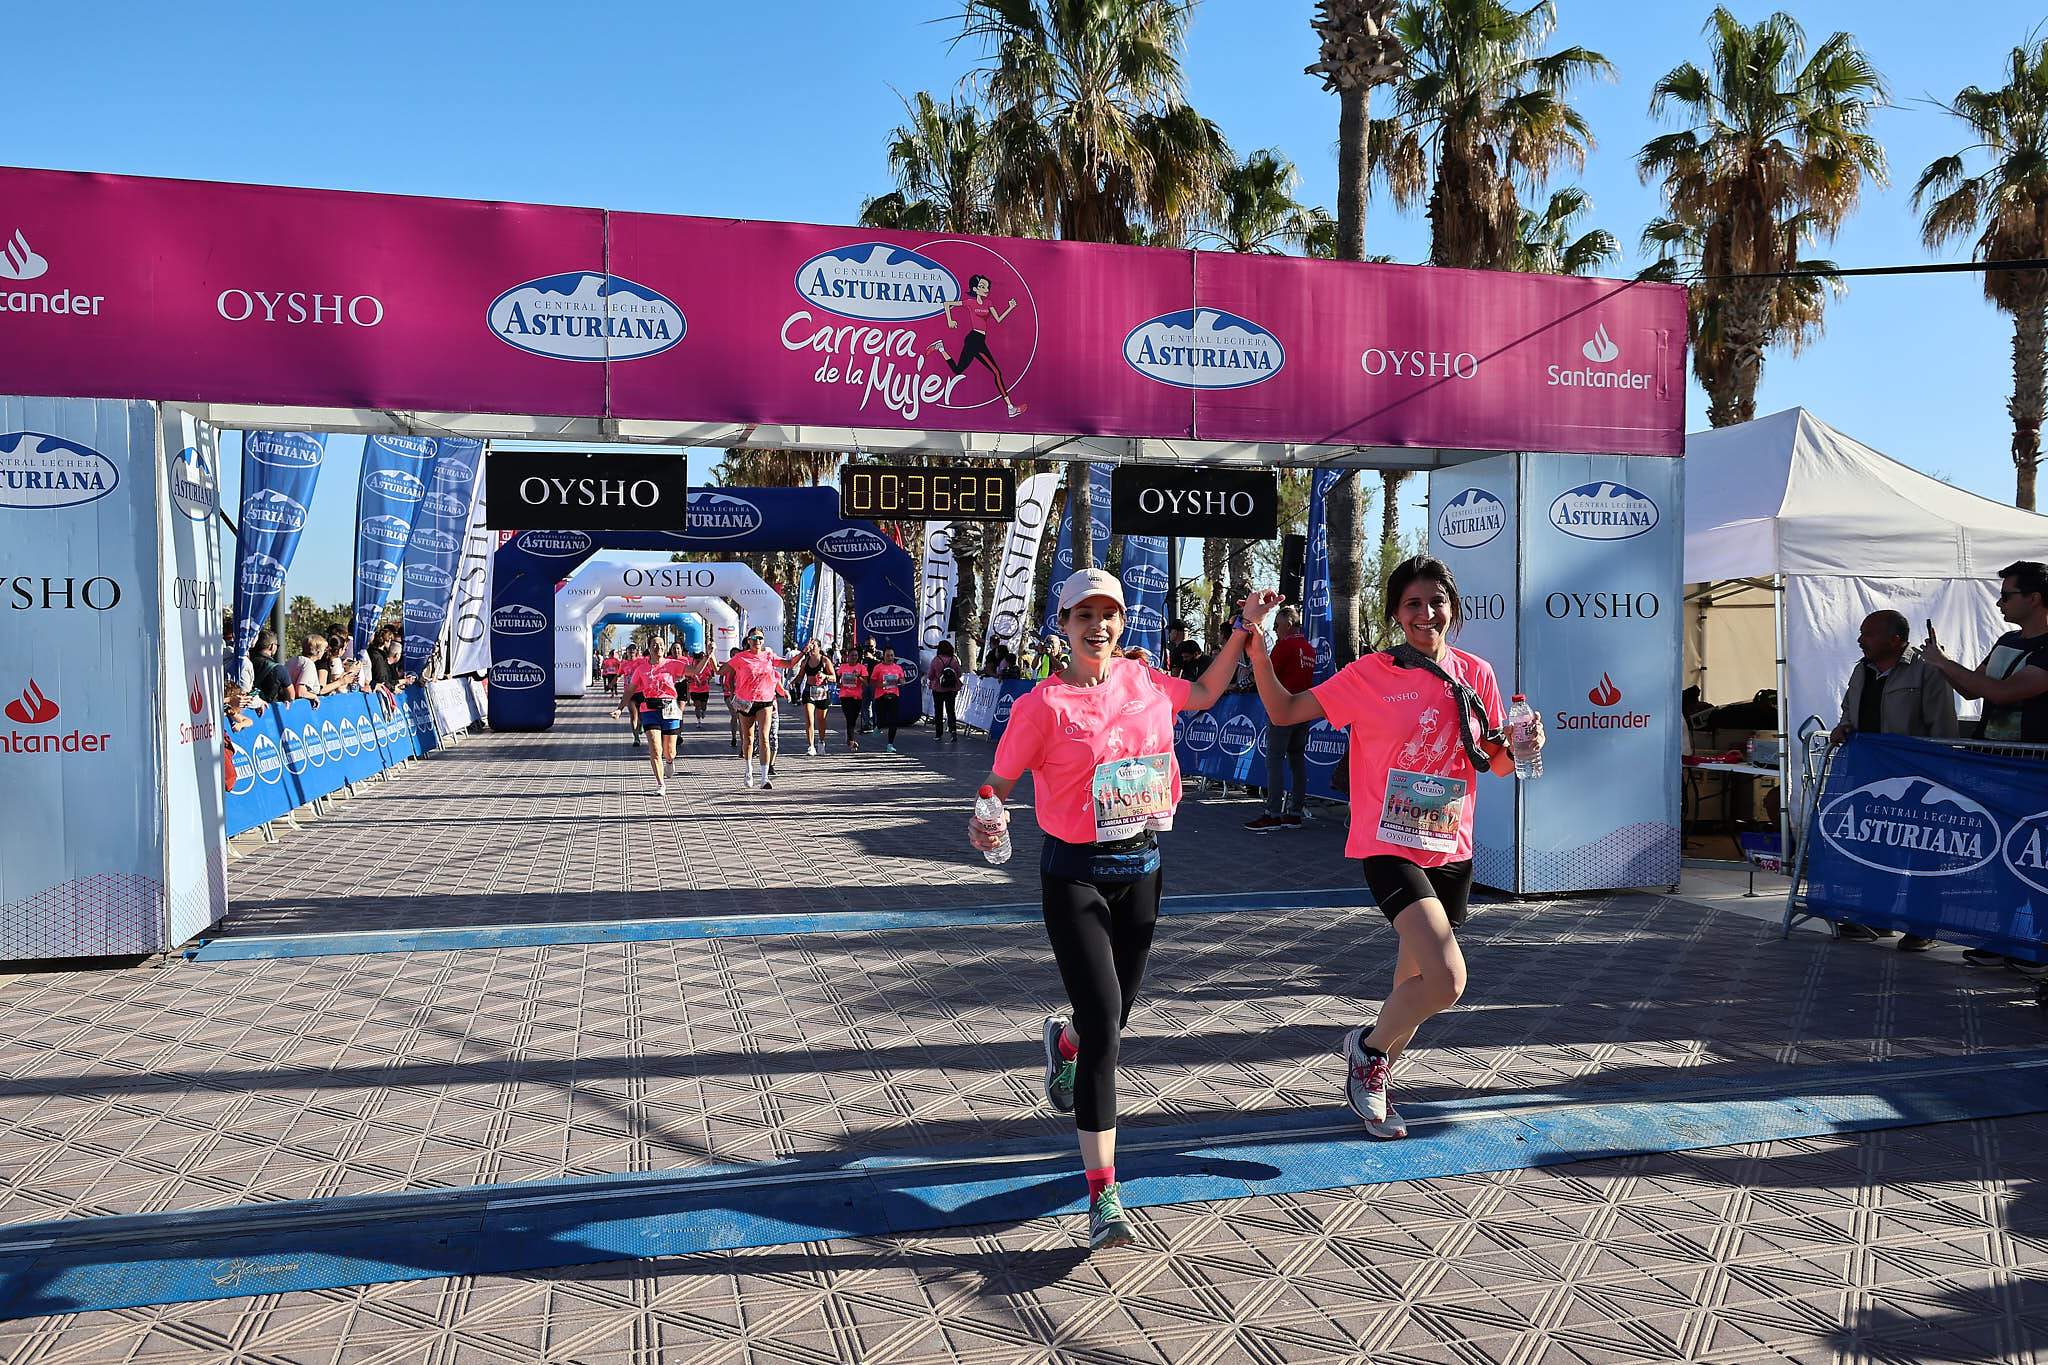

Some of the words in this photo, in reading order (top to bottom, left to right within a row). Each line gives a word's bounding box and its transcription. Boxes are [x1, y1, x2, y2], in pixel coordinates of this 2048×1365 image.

[834, 267, 887, 278] CENTRAL
[890, 270, 943, 282] LECHERA
[216, 288, 385, 328] OYSHO
[534, 300, 597, 312] CENTRAL
[780, 311, 917, 357] Carrera
[1161, 334, 1212, 345] CENTRAL
[1216, 336, 1268, 347] LECHERA
[1360, 348, 1479, 380] OYSHO
[814, 355, 840, 385] de
[845, 355, 864, 385] la
[860, 354, 967, 421] Mujer
[1547, 364, 1652, 390] Santander
[41, 459, 100, 468] LECHERA
[519, 476, 660, 508] OYSHO
[853, 474, 1003, 512] 00:36:28
[1138, 488, 1255, 517] OYSHO
[422, 502, 462, 515] STURIANA
[1556, 502, 1651, 527] ASTURIANA
[362, 522, 409, 542] ASTURIAN
[1442, 513, 1501, 537] ASTURIANA
[521, 536, 586, 550] ASTURIANA
[822, 541, 882, 553] ASTURIANA
[623, 568, 715, 588] OYSHO
[993, 498, 1044, 641] OYSHO
[173, 576, 217, 611] OYSHO
[739, 588, 768, 596] OYSHO
[1545, 592, 1659, 619] OYSHO
[492, 615, 543, 629] ASTURIANA
[491, 669, 542, 682] ASTURIANA
[1556, 710, 1651, 730] Santander
[1865, 803, 1919, 819] CENTRAL
[1923, 810, 1983, 828] LECHERA
[1832, 804, 1983, 859] ASTURIANA
